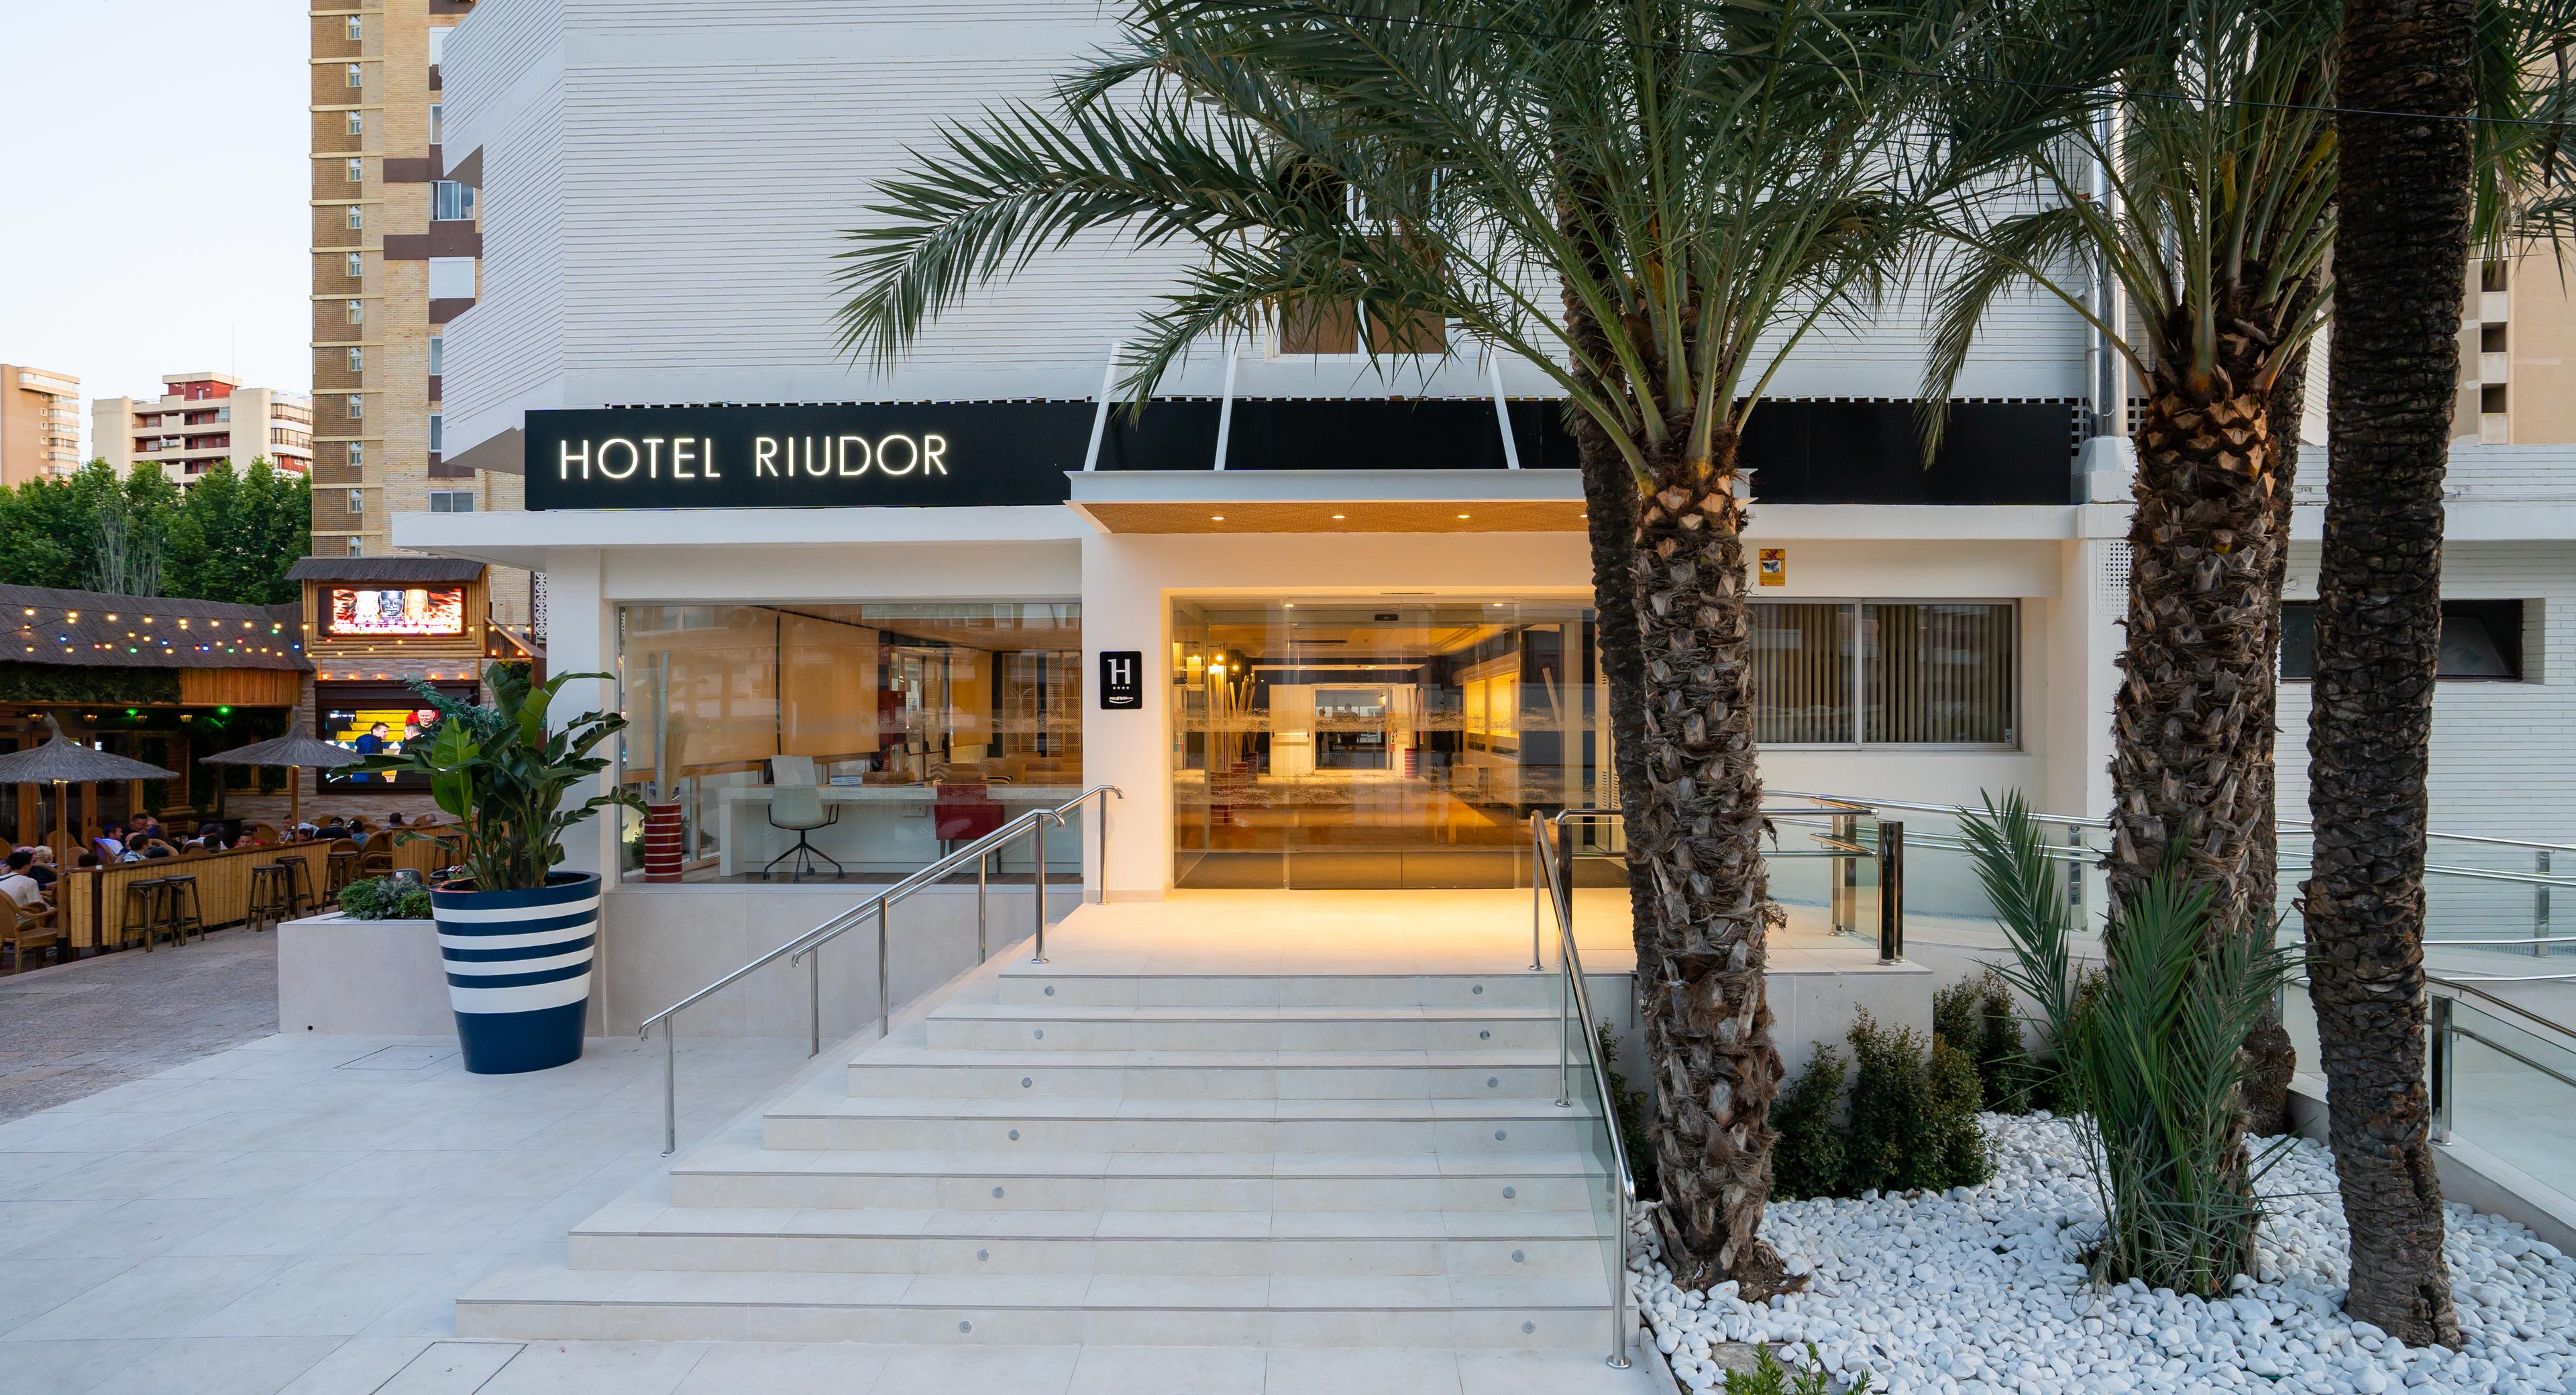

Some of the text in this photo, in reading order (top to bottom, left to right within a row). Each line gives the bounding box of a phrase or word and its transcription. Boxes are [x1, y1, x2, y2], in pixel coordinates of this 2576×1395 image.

[560, 433, 948, 480] HOTEL RIUDOR
[1108, 658, 1131, 684] H
